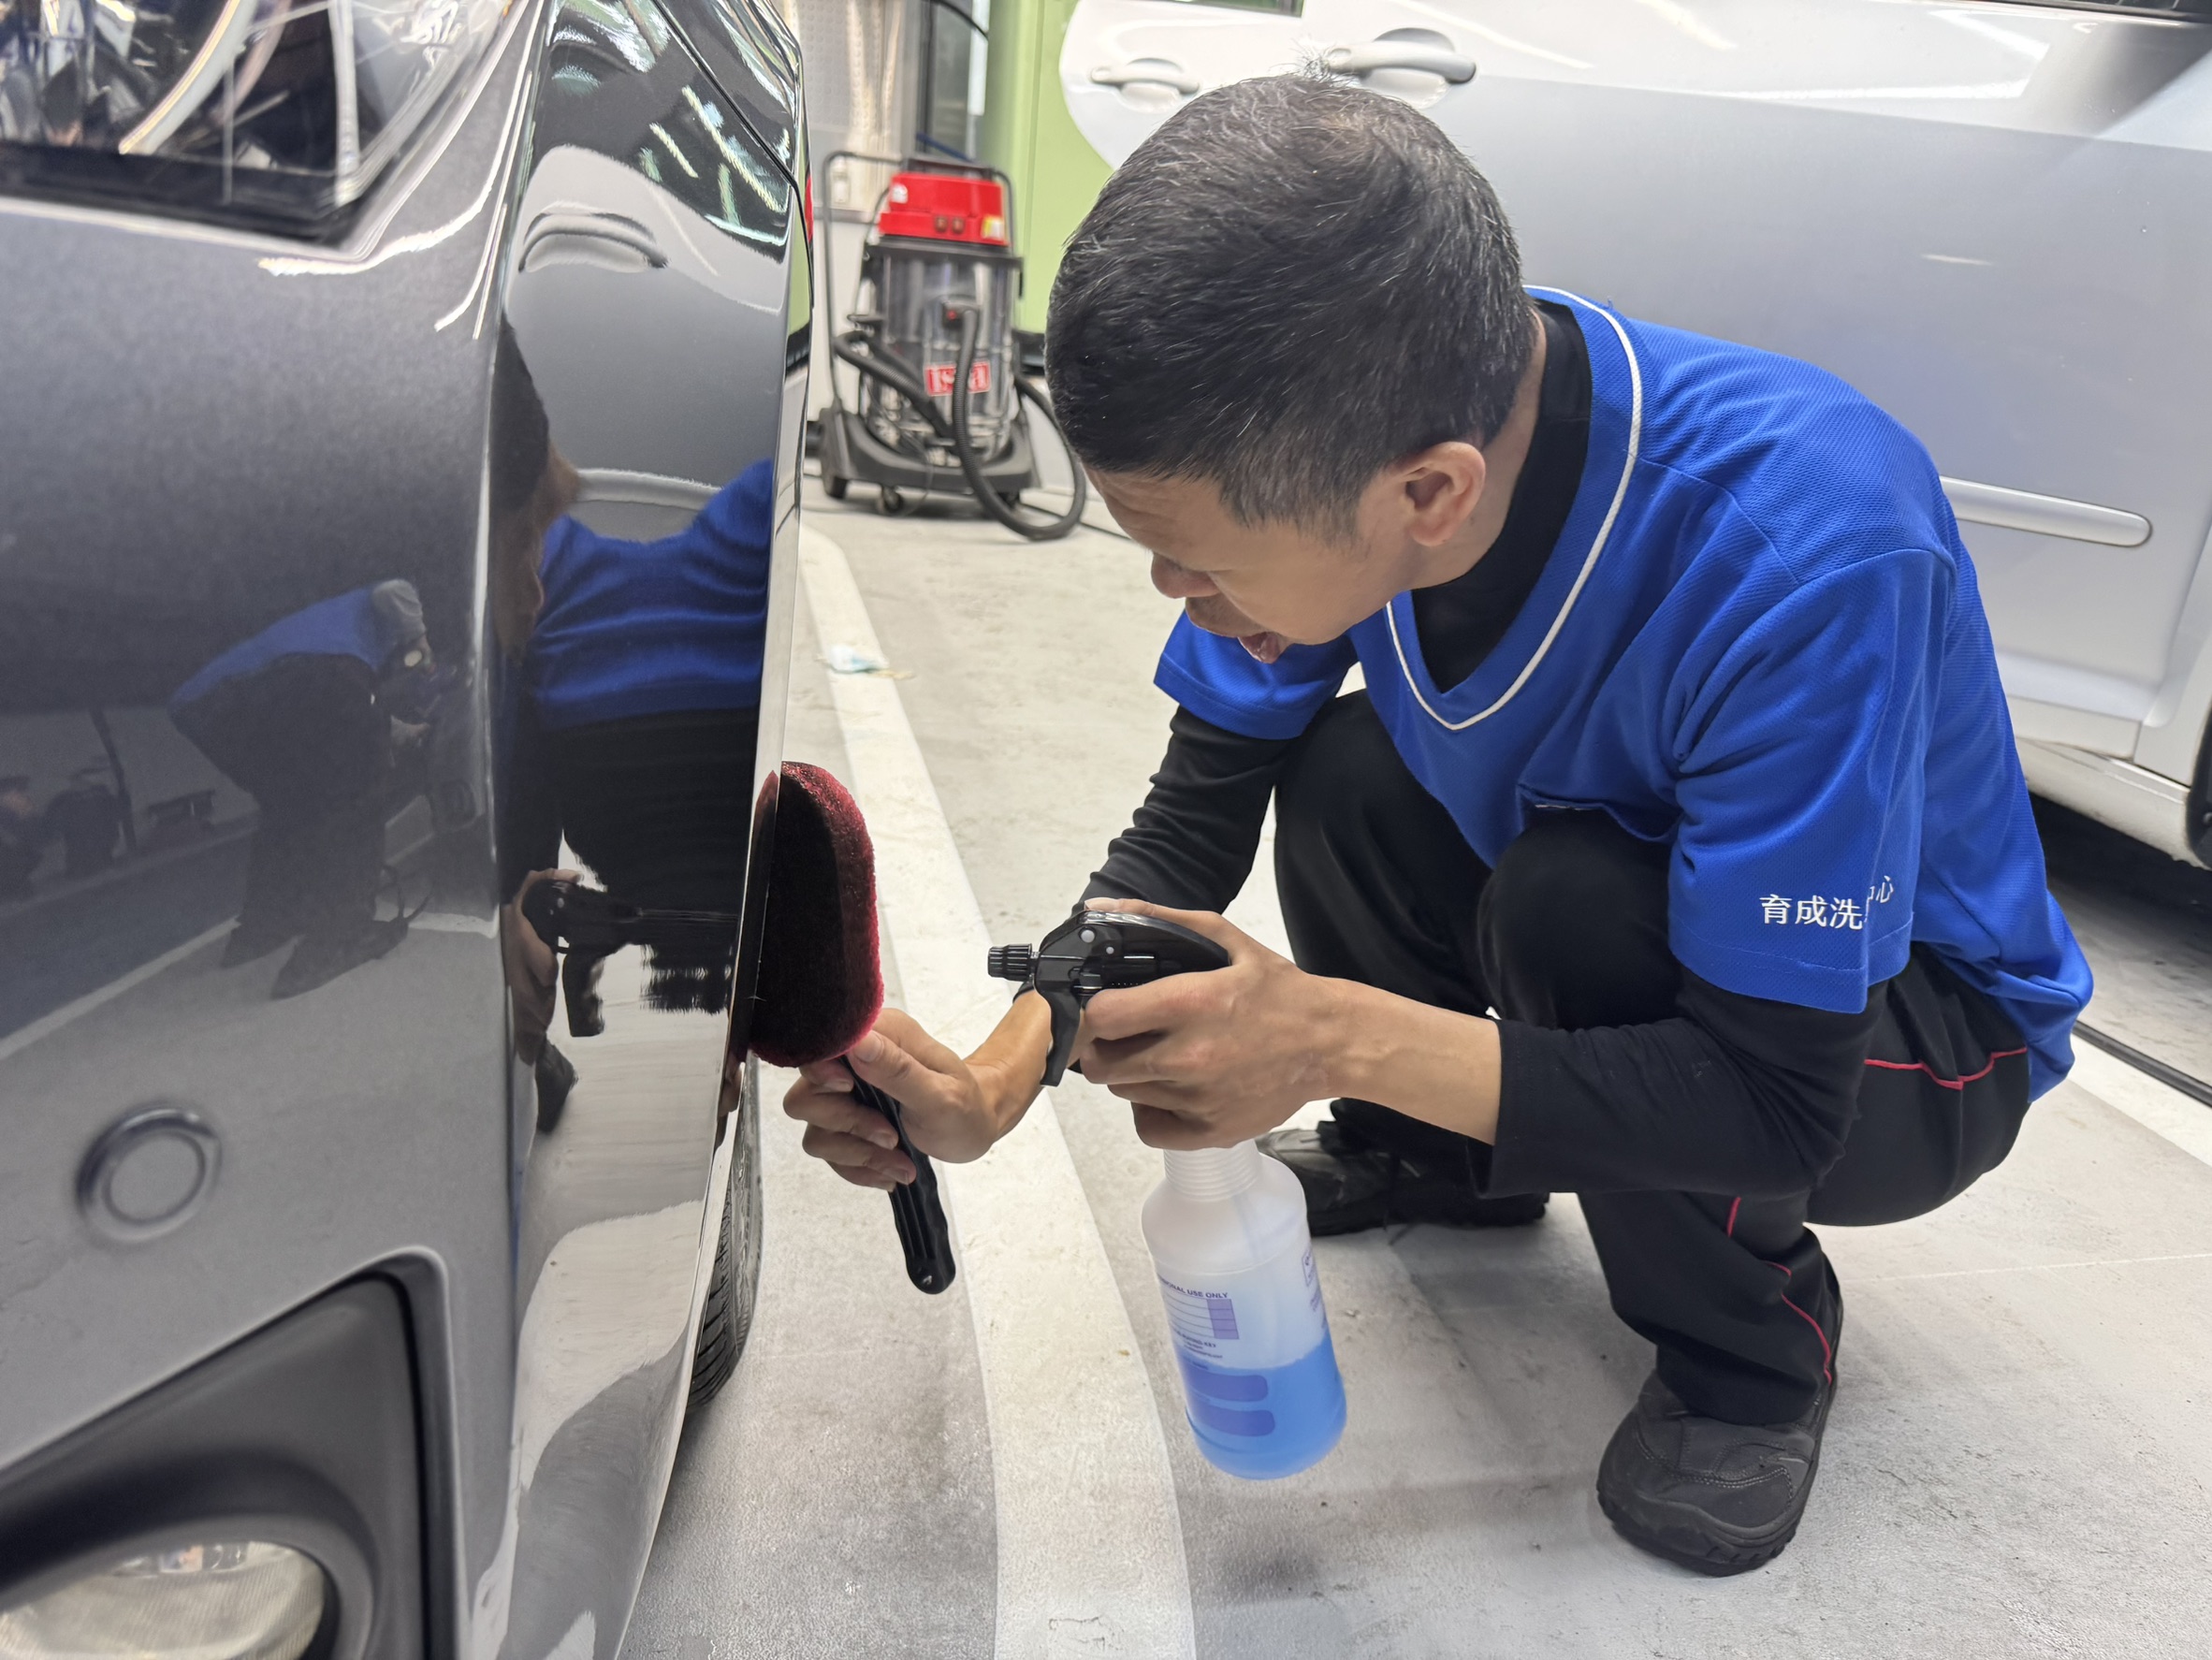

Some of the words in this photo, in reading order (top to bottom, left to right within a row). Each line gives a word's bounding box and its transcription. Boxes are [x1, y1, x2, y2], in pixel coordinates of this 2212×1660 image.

[1759, 875, 1894, 930] 育成洗心
[1186, 1289, 1203, 1298] USE
